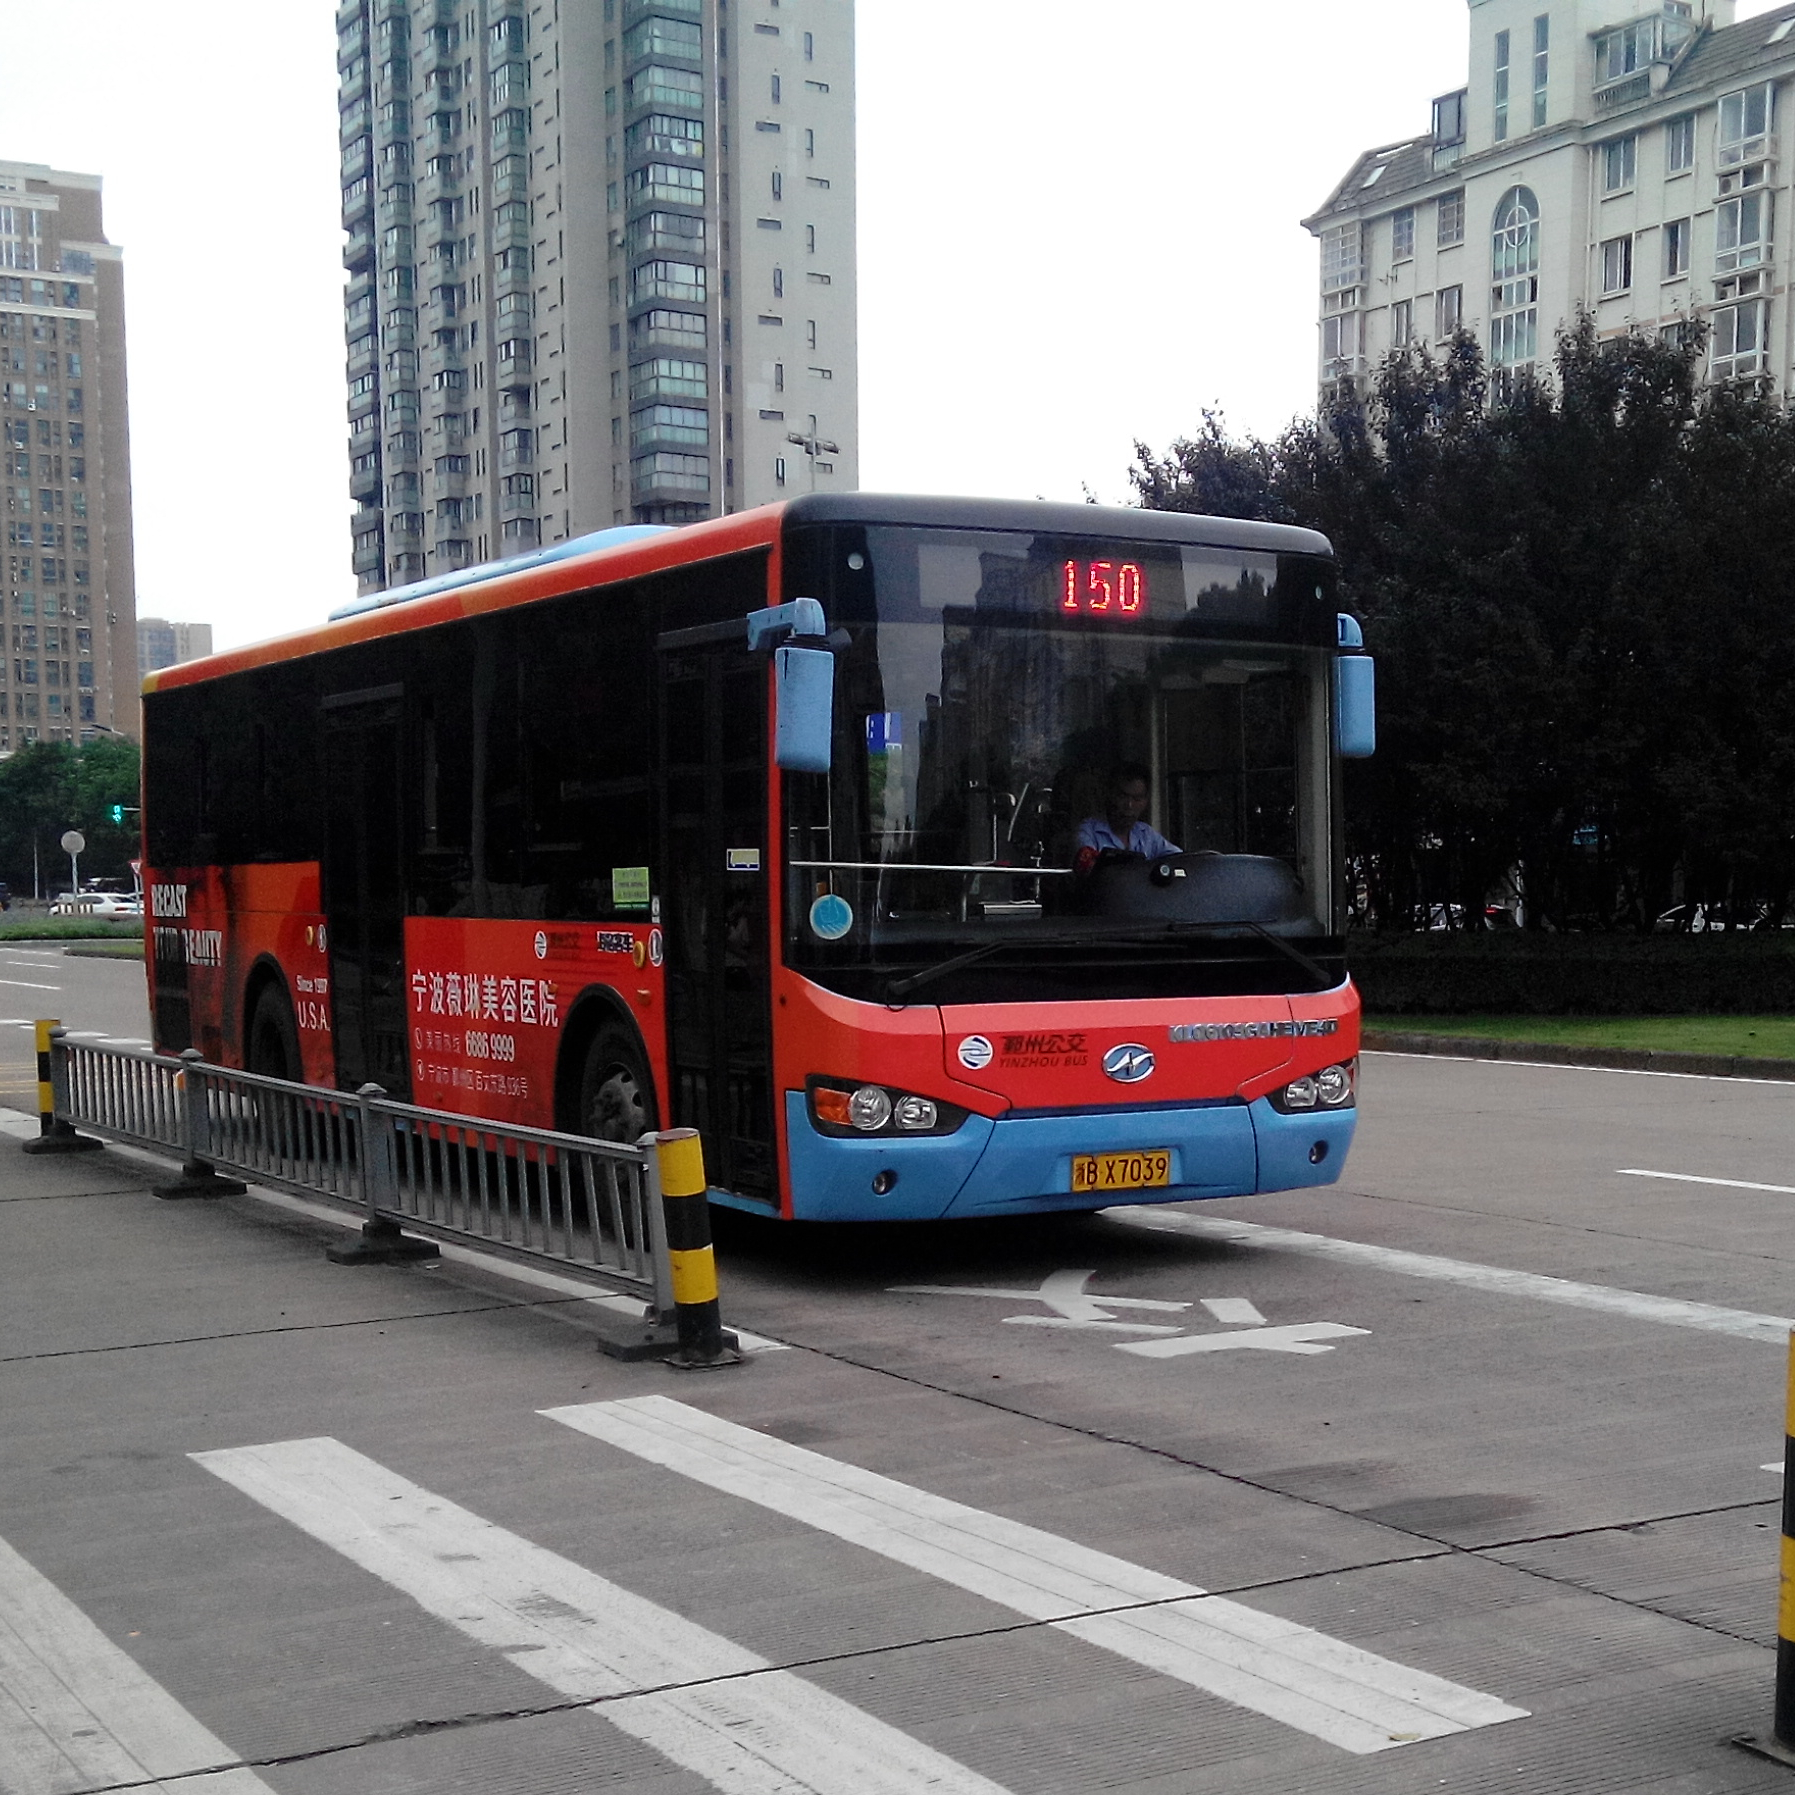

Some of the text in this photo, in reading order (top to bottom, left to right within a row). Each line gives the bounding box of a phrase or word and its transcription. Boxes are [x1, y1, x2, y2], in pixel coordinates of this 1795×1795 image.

[1064, 560, 1140, 611] 150
[151, 884, 187, 918] RECAST
[181, 928, 222, 967] BEAUTY
[411, 968, 559, 1028] 宁波薇琳美容医院
[465, 1030, 489, 1059] 6686
[490, 1033, 515, 1063] 9999
[1000, 1055, 1088, 1068] YINZHOU BUS
